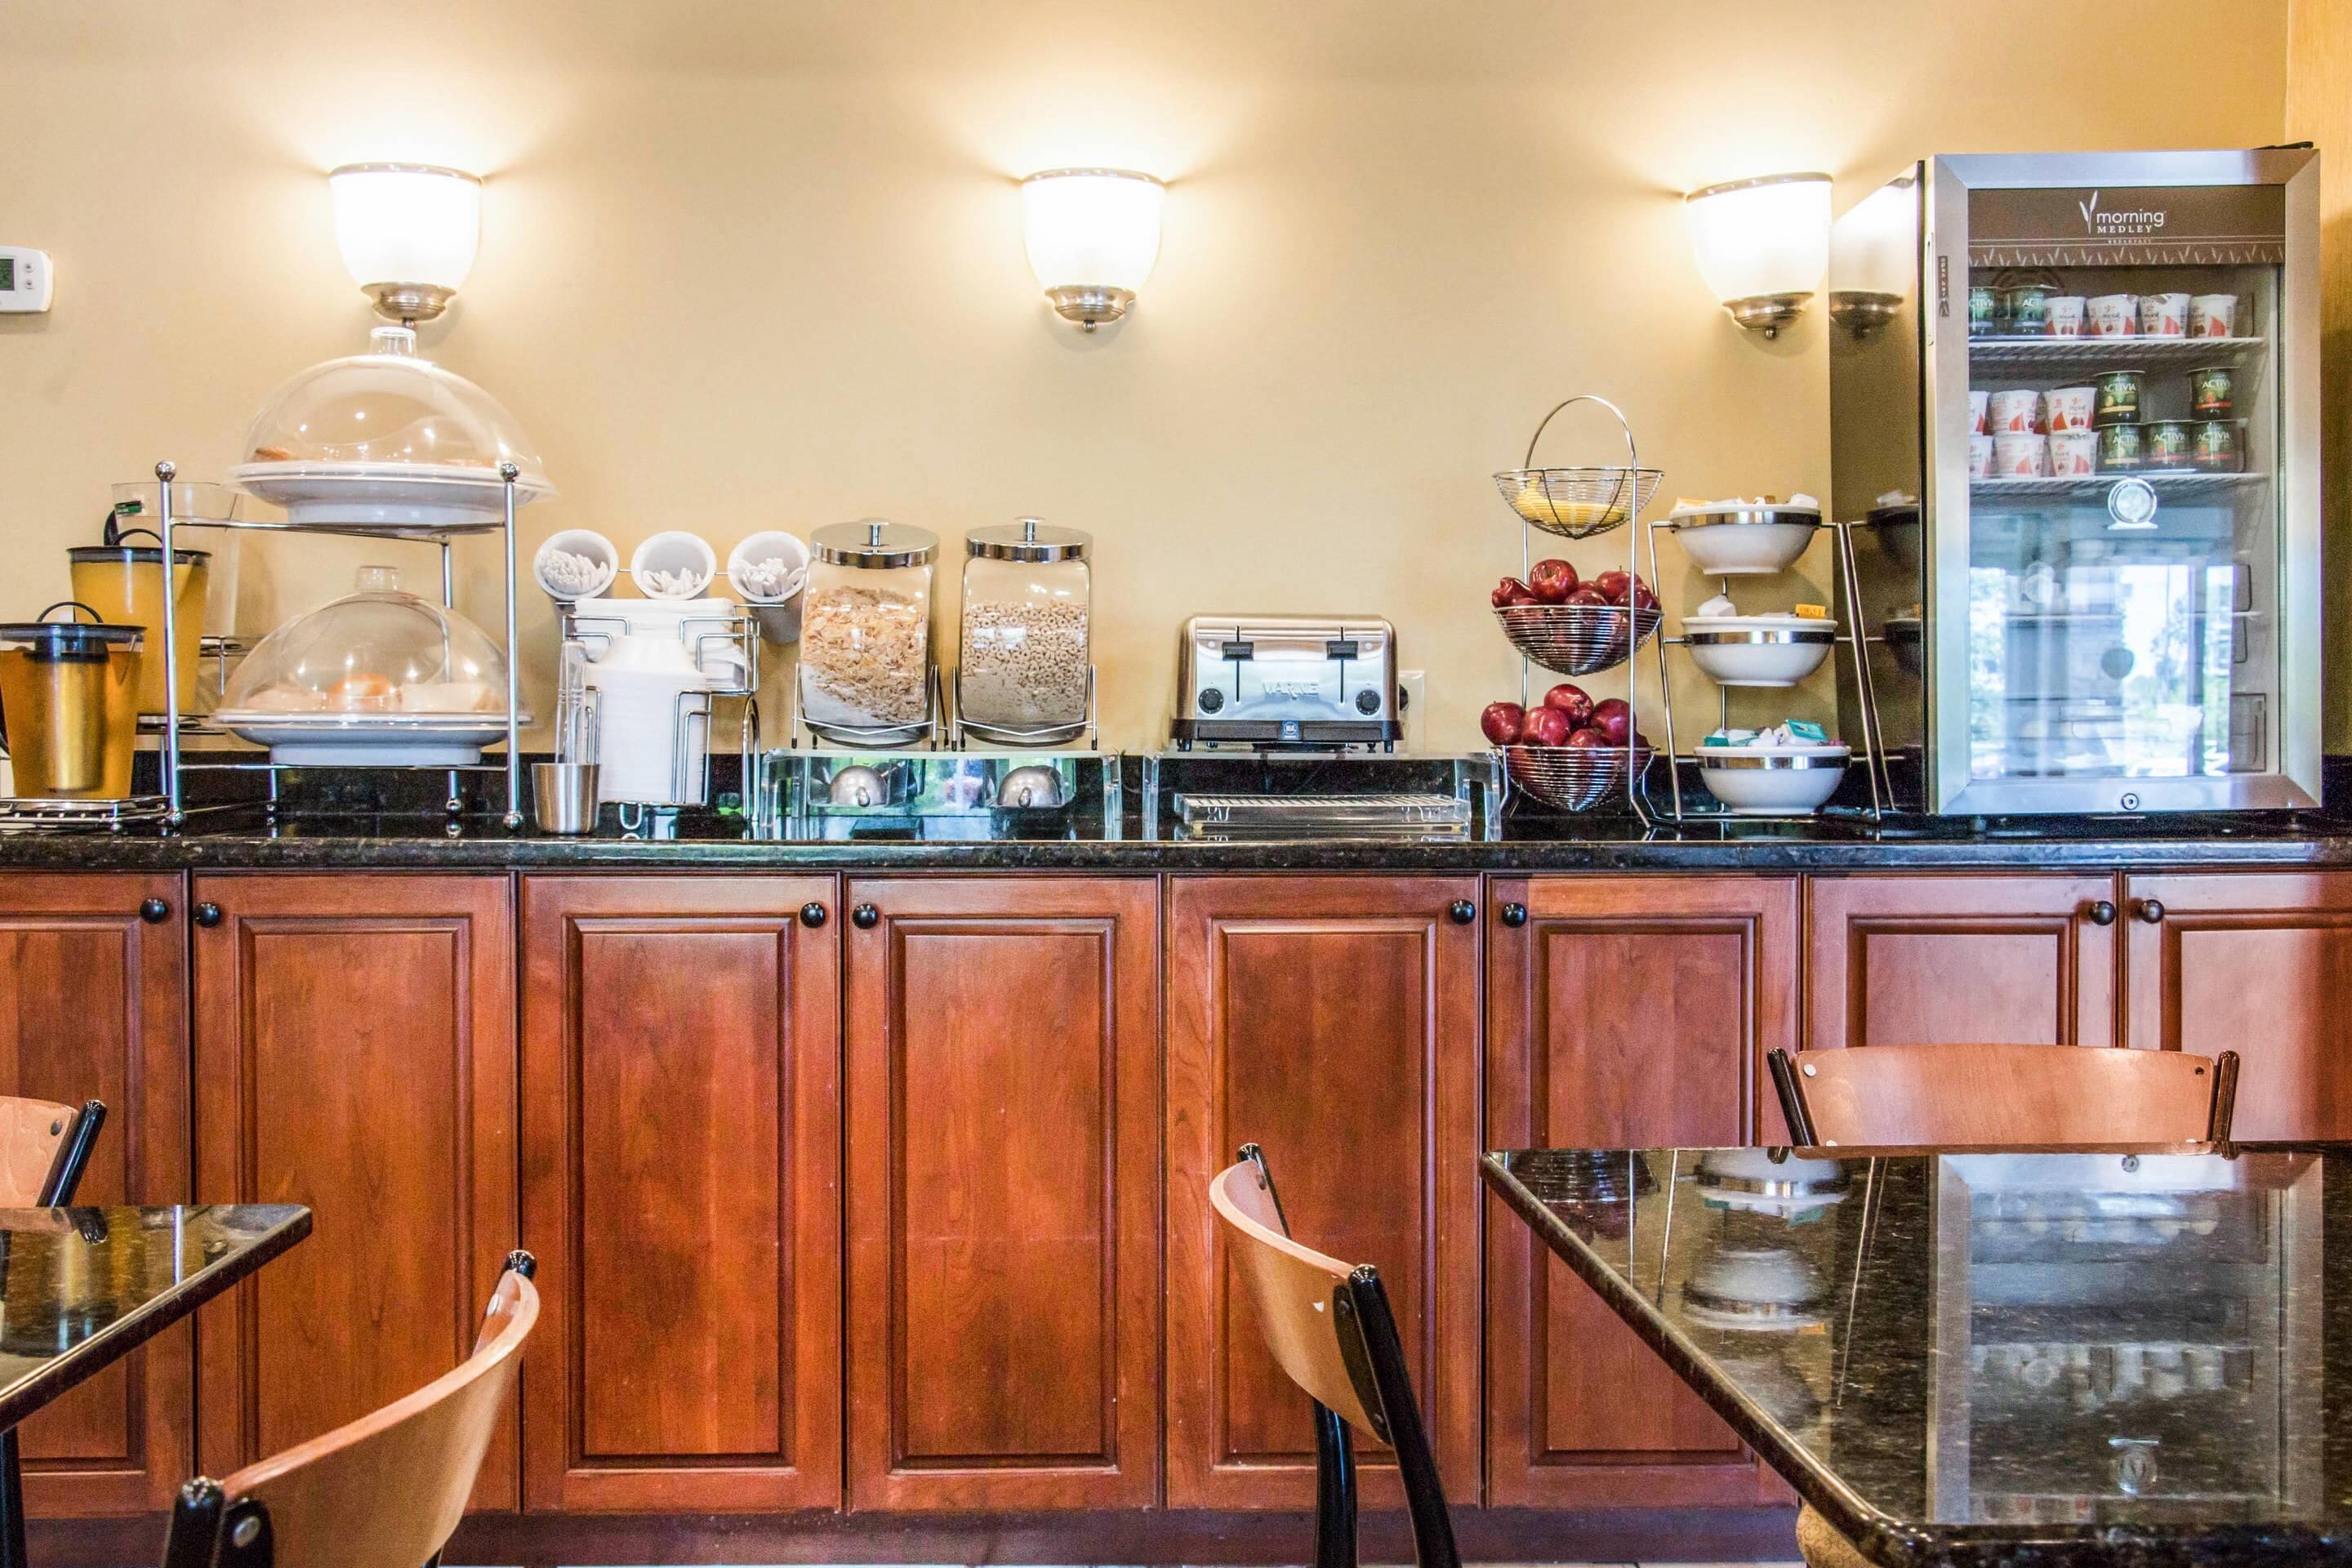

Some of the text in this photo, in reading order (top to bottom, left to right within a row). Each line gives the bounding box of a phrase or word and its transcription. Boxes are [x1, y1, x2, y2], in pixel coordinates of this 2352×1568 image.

[2096, 208, 2164, 227] morning
[2097, 225, 2153, 234] MEDLEY
[2104, 383, 2136, 393] ACTIVIA
[2197, 431, 2230, 441] ACTIVIA
